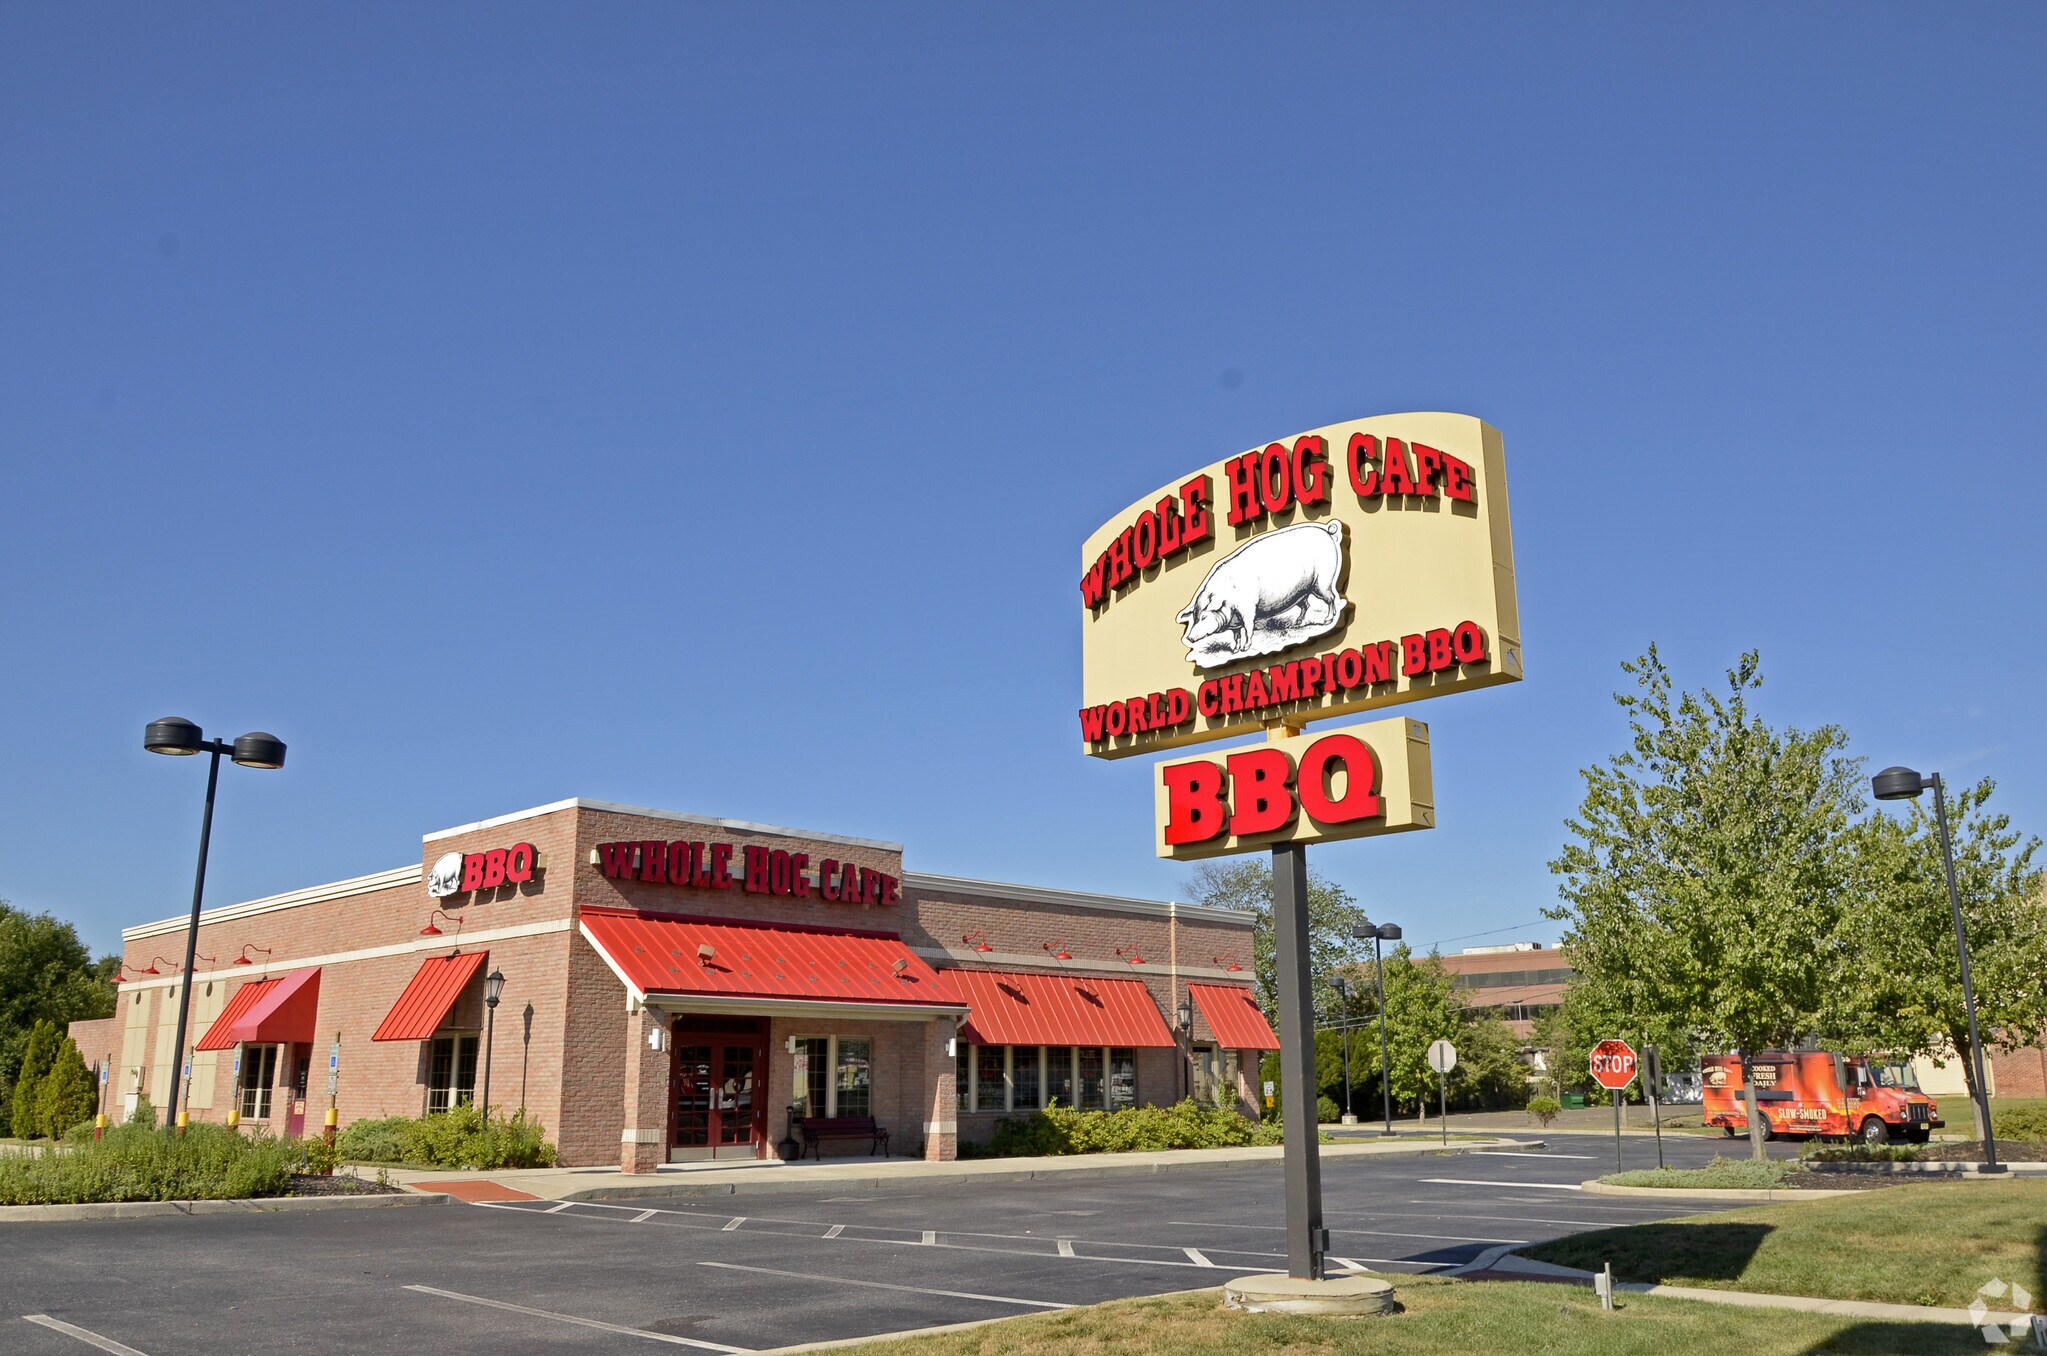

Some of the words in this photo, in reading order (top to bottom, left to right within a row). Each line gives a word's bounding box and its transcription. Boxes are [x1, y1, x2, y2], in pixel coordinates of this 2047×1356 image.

[1080, 474, 1209, 609] WHOLE
[1225, 435, 1328, 527] HOG
[1346, 432, 1473, 502] CAFE
[1079, 687, 1190, 743] WORLD
[1197, 639, 1392, 718] CHAMPION
[1401, 620, 1486, 677] BBQ
[1162, 734, 1381, 846] BBQ
[461, 842, 534, 893] BBQ
[598, 840, 734, 891] WHOLE
[744, 845, 812, 898] HOG
[821, 858, 899, 907] CAFE
[1593, 1054, 1634, 1074] STOP
[1778, 1107, 1827, 1120] SLOW-SMOKED
